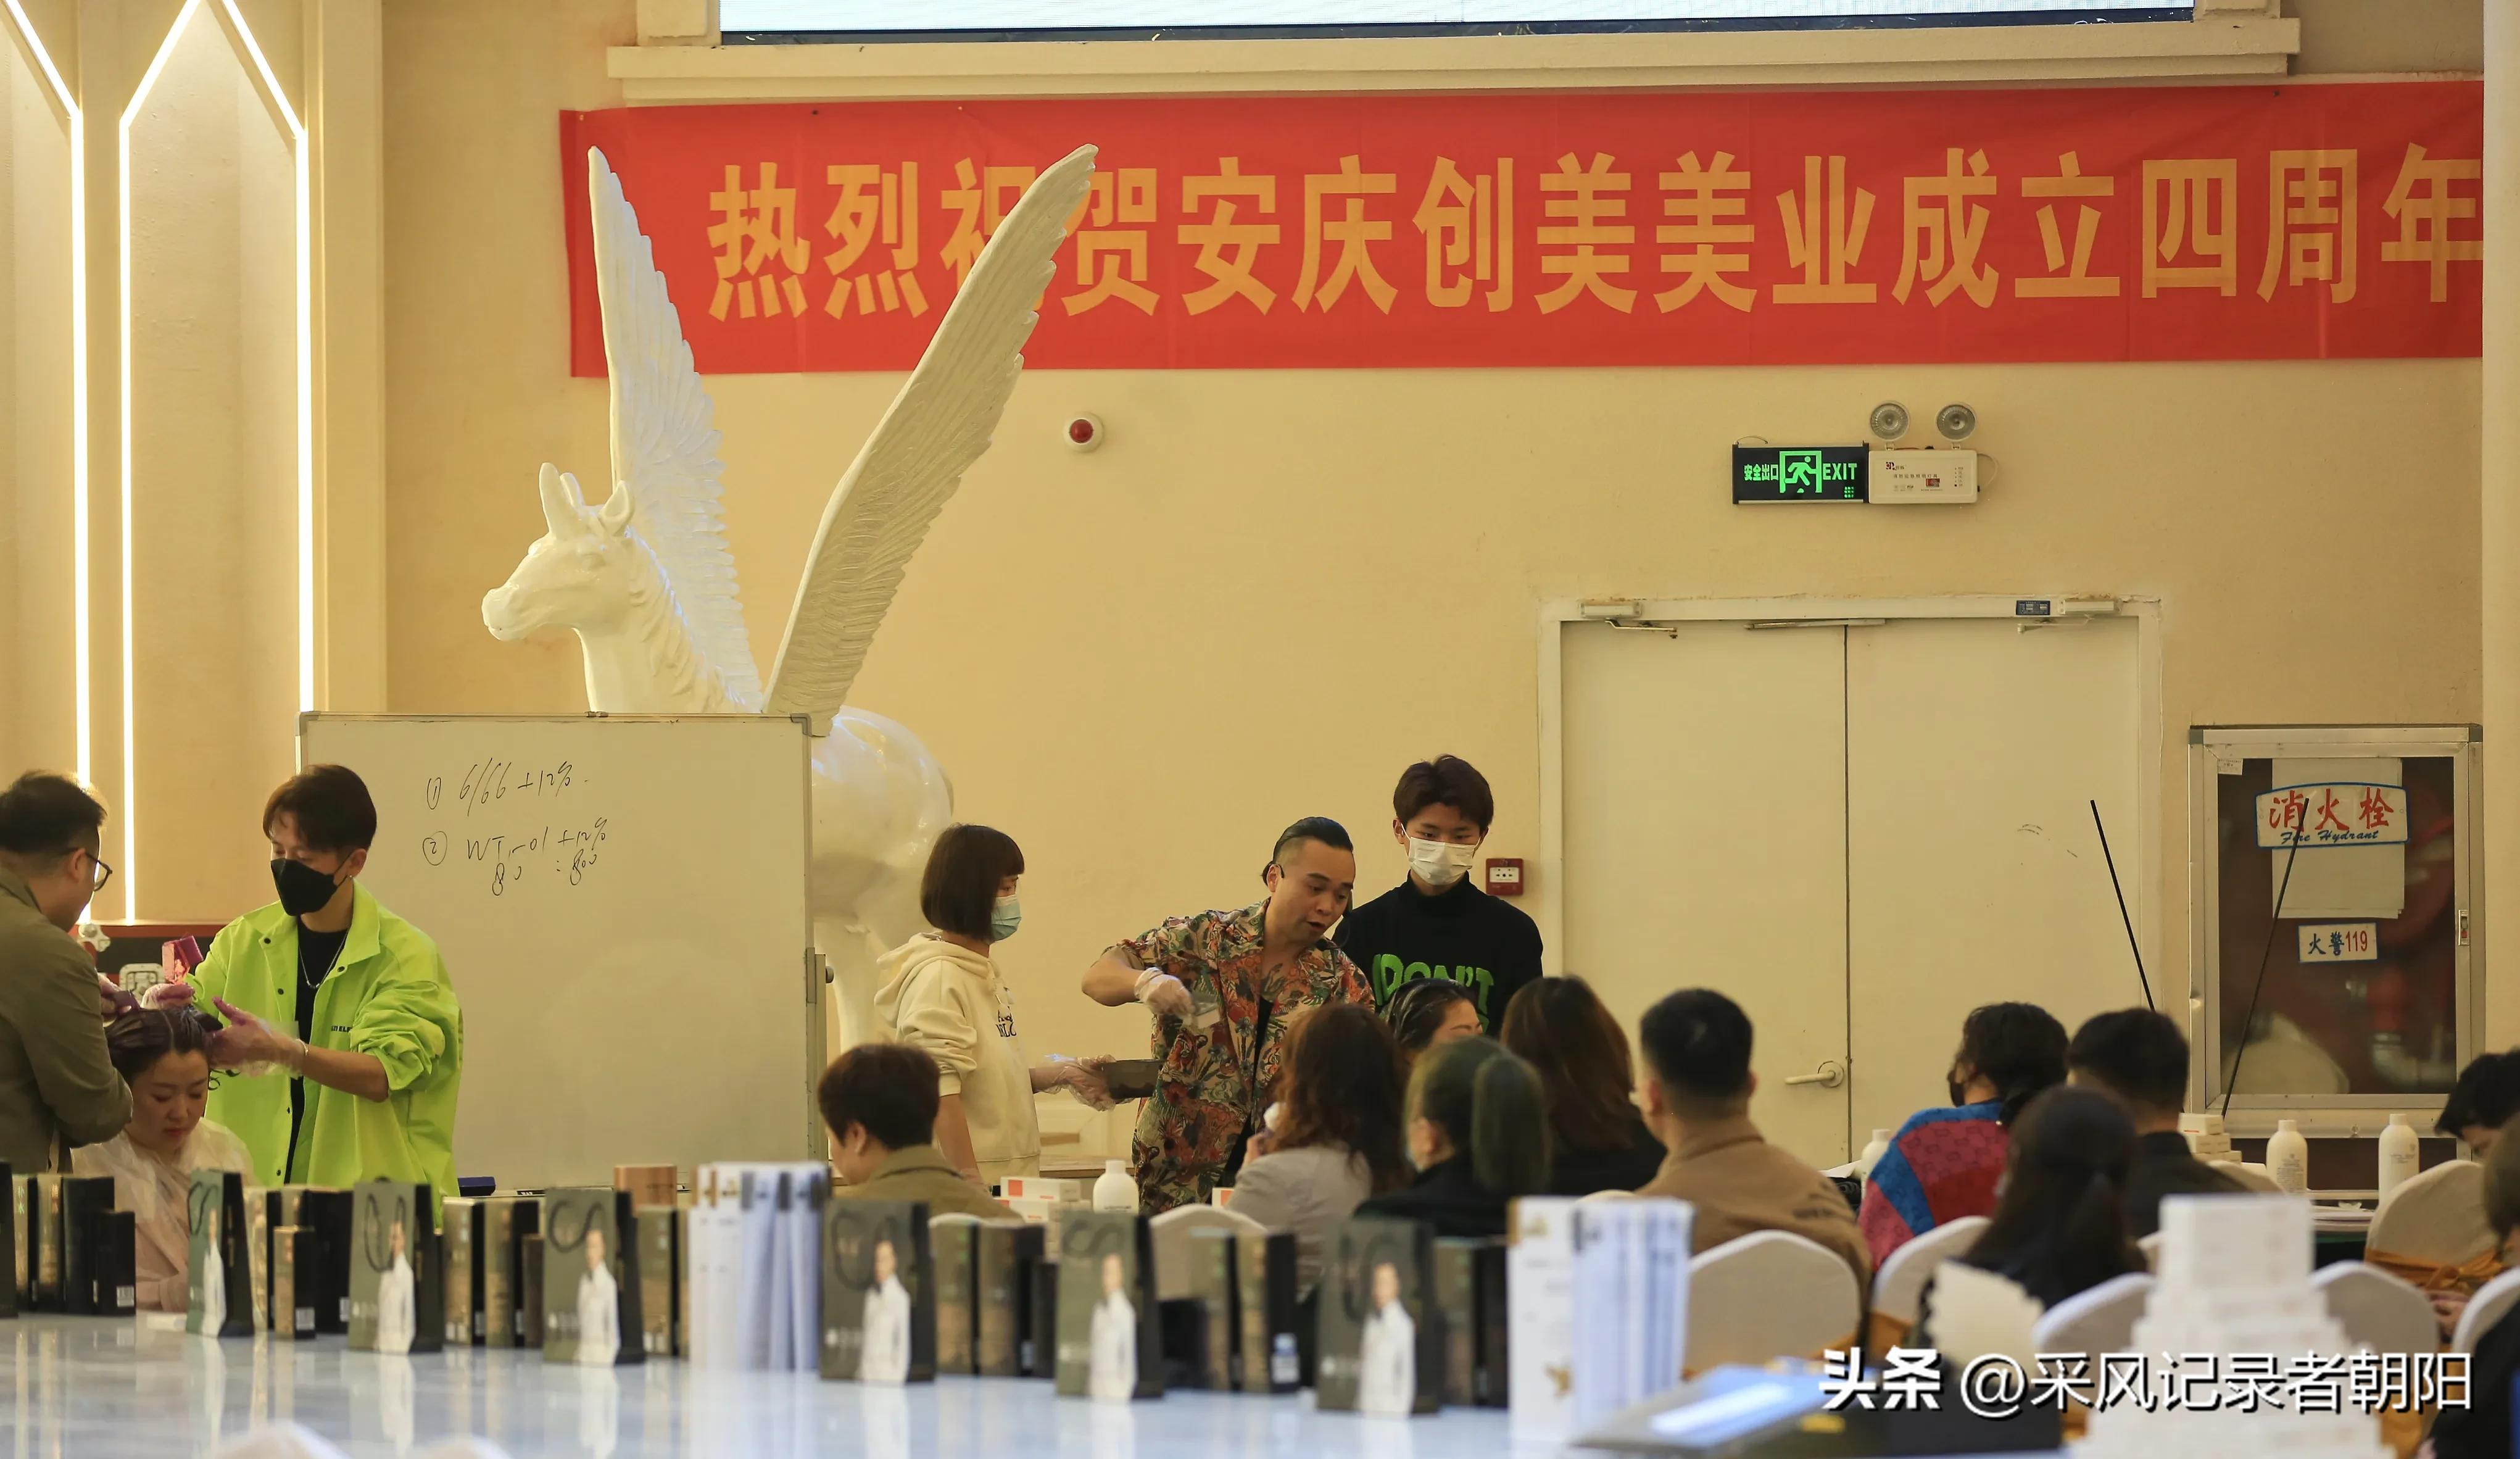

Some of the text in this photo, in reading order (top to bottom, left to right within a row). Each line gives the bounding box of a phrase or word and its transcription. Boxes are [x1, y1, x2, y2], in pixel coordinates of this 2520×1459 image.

[1744, 463, 1858, 481] 安全出口 EXIT
[2269, 787, 2394, 832] 消火栓
[2280, 829, 2379, 845] Fre Hydrant
